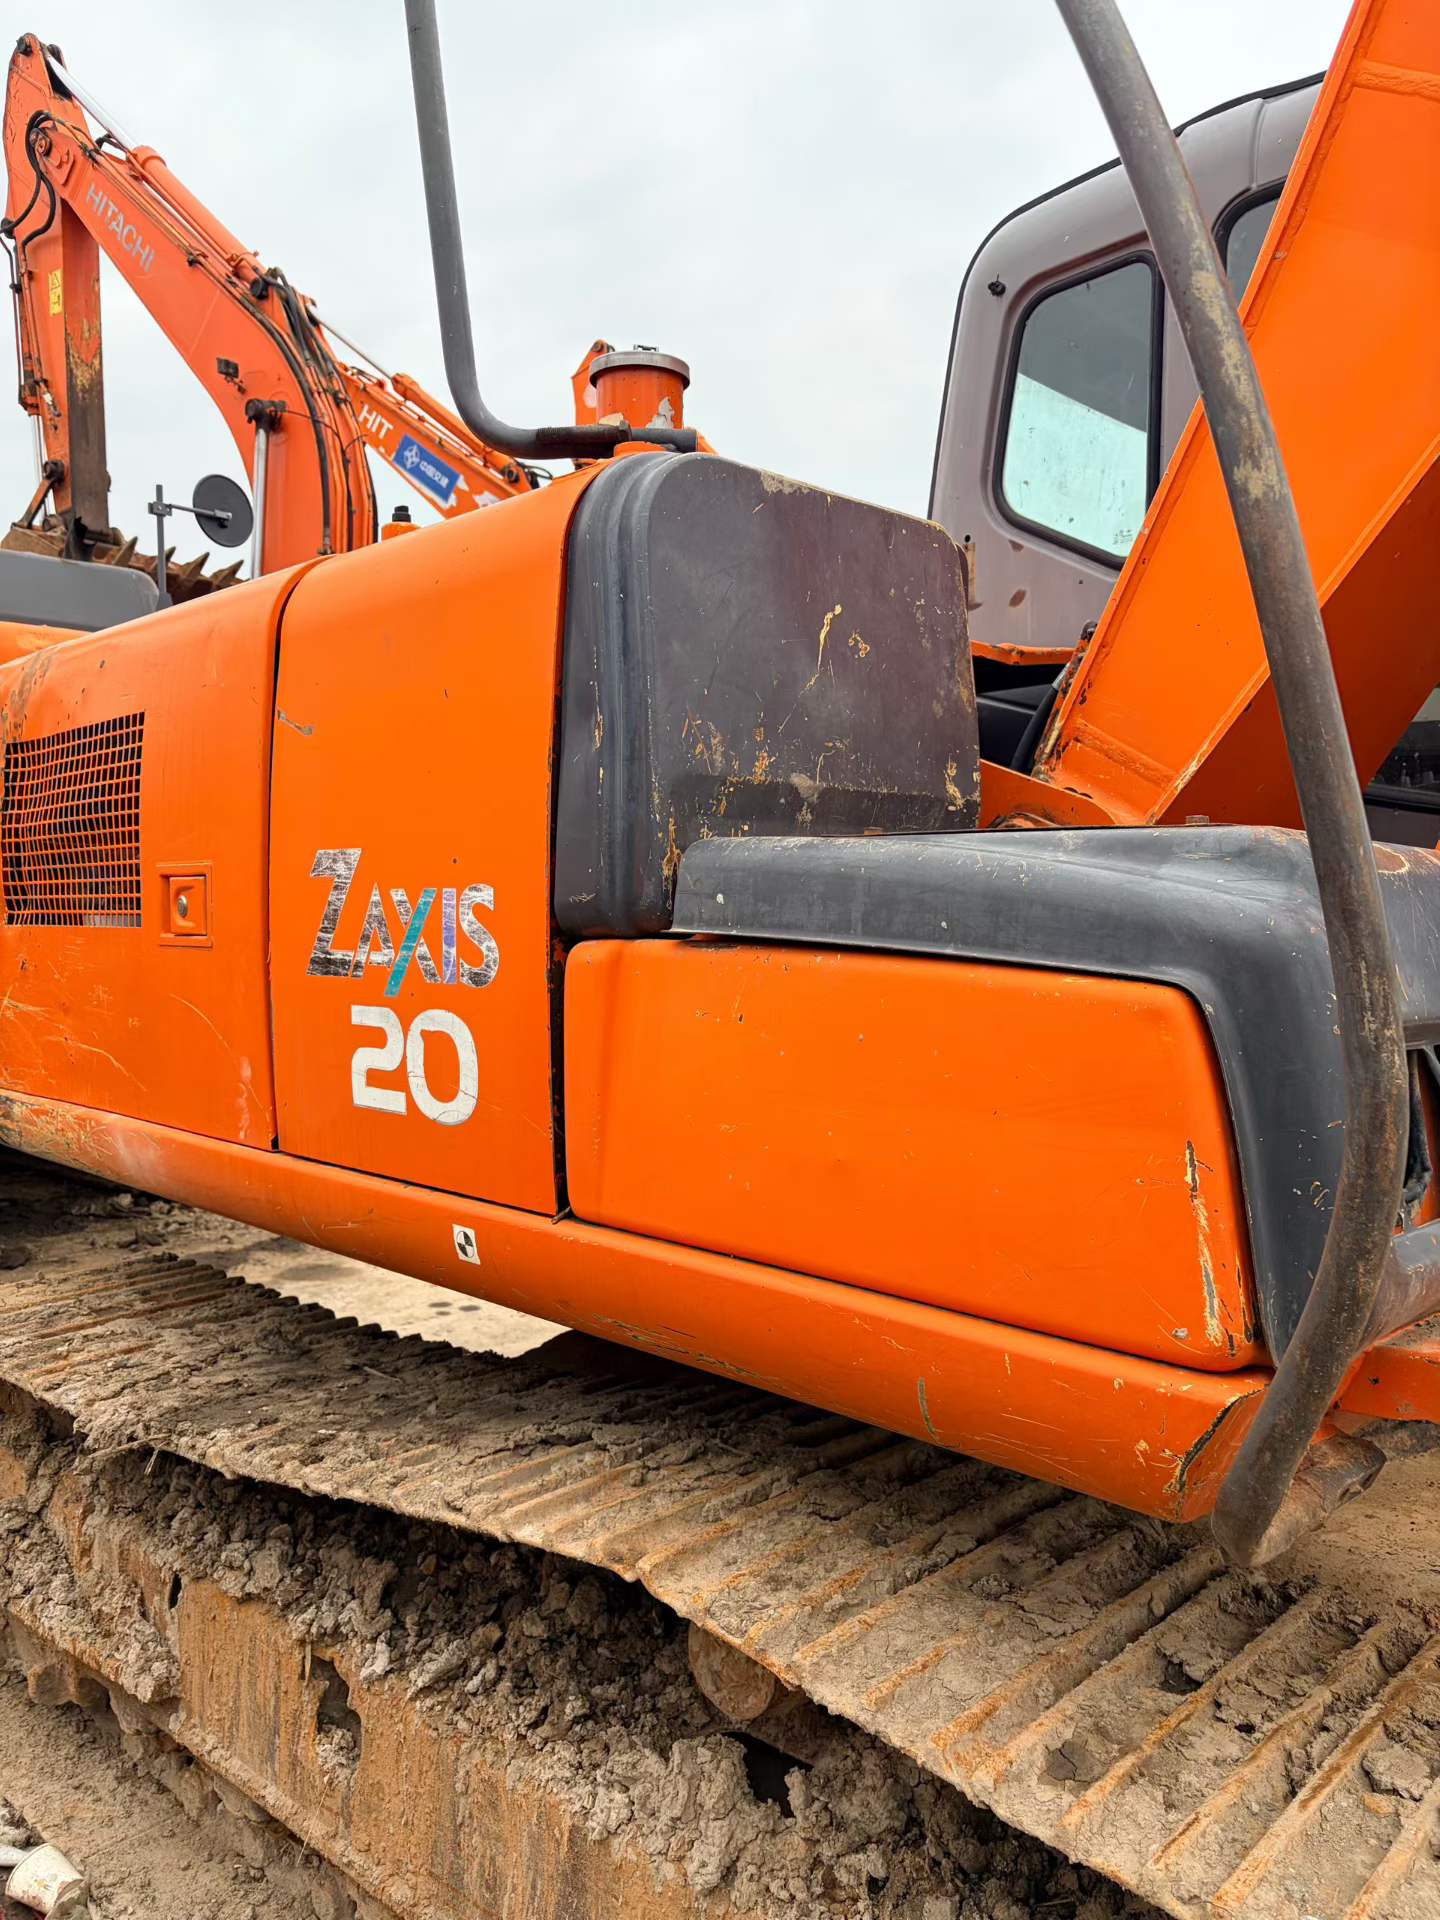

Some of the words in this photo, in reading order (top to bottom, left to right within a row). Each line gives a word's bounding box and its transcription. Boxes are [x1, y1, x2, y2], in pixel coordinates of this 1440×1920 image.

[86, 184, 155, 272] HITACHI
[306, 847, 500, 997] ZAXIS
[351, 1004, 479, 1126] 20
